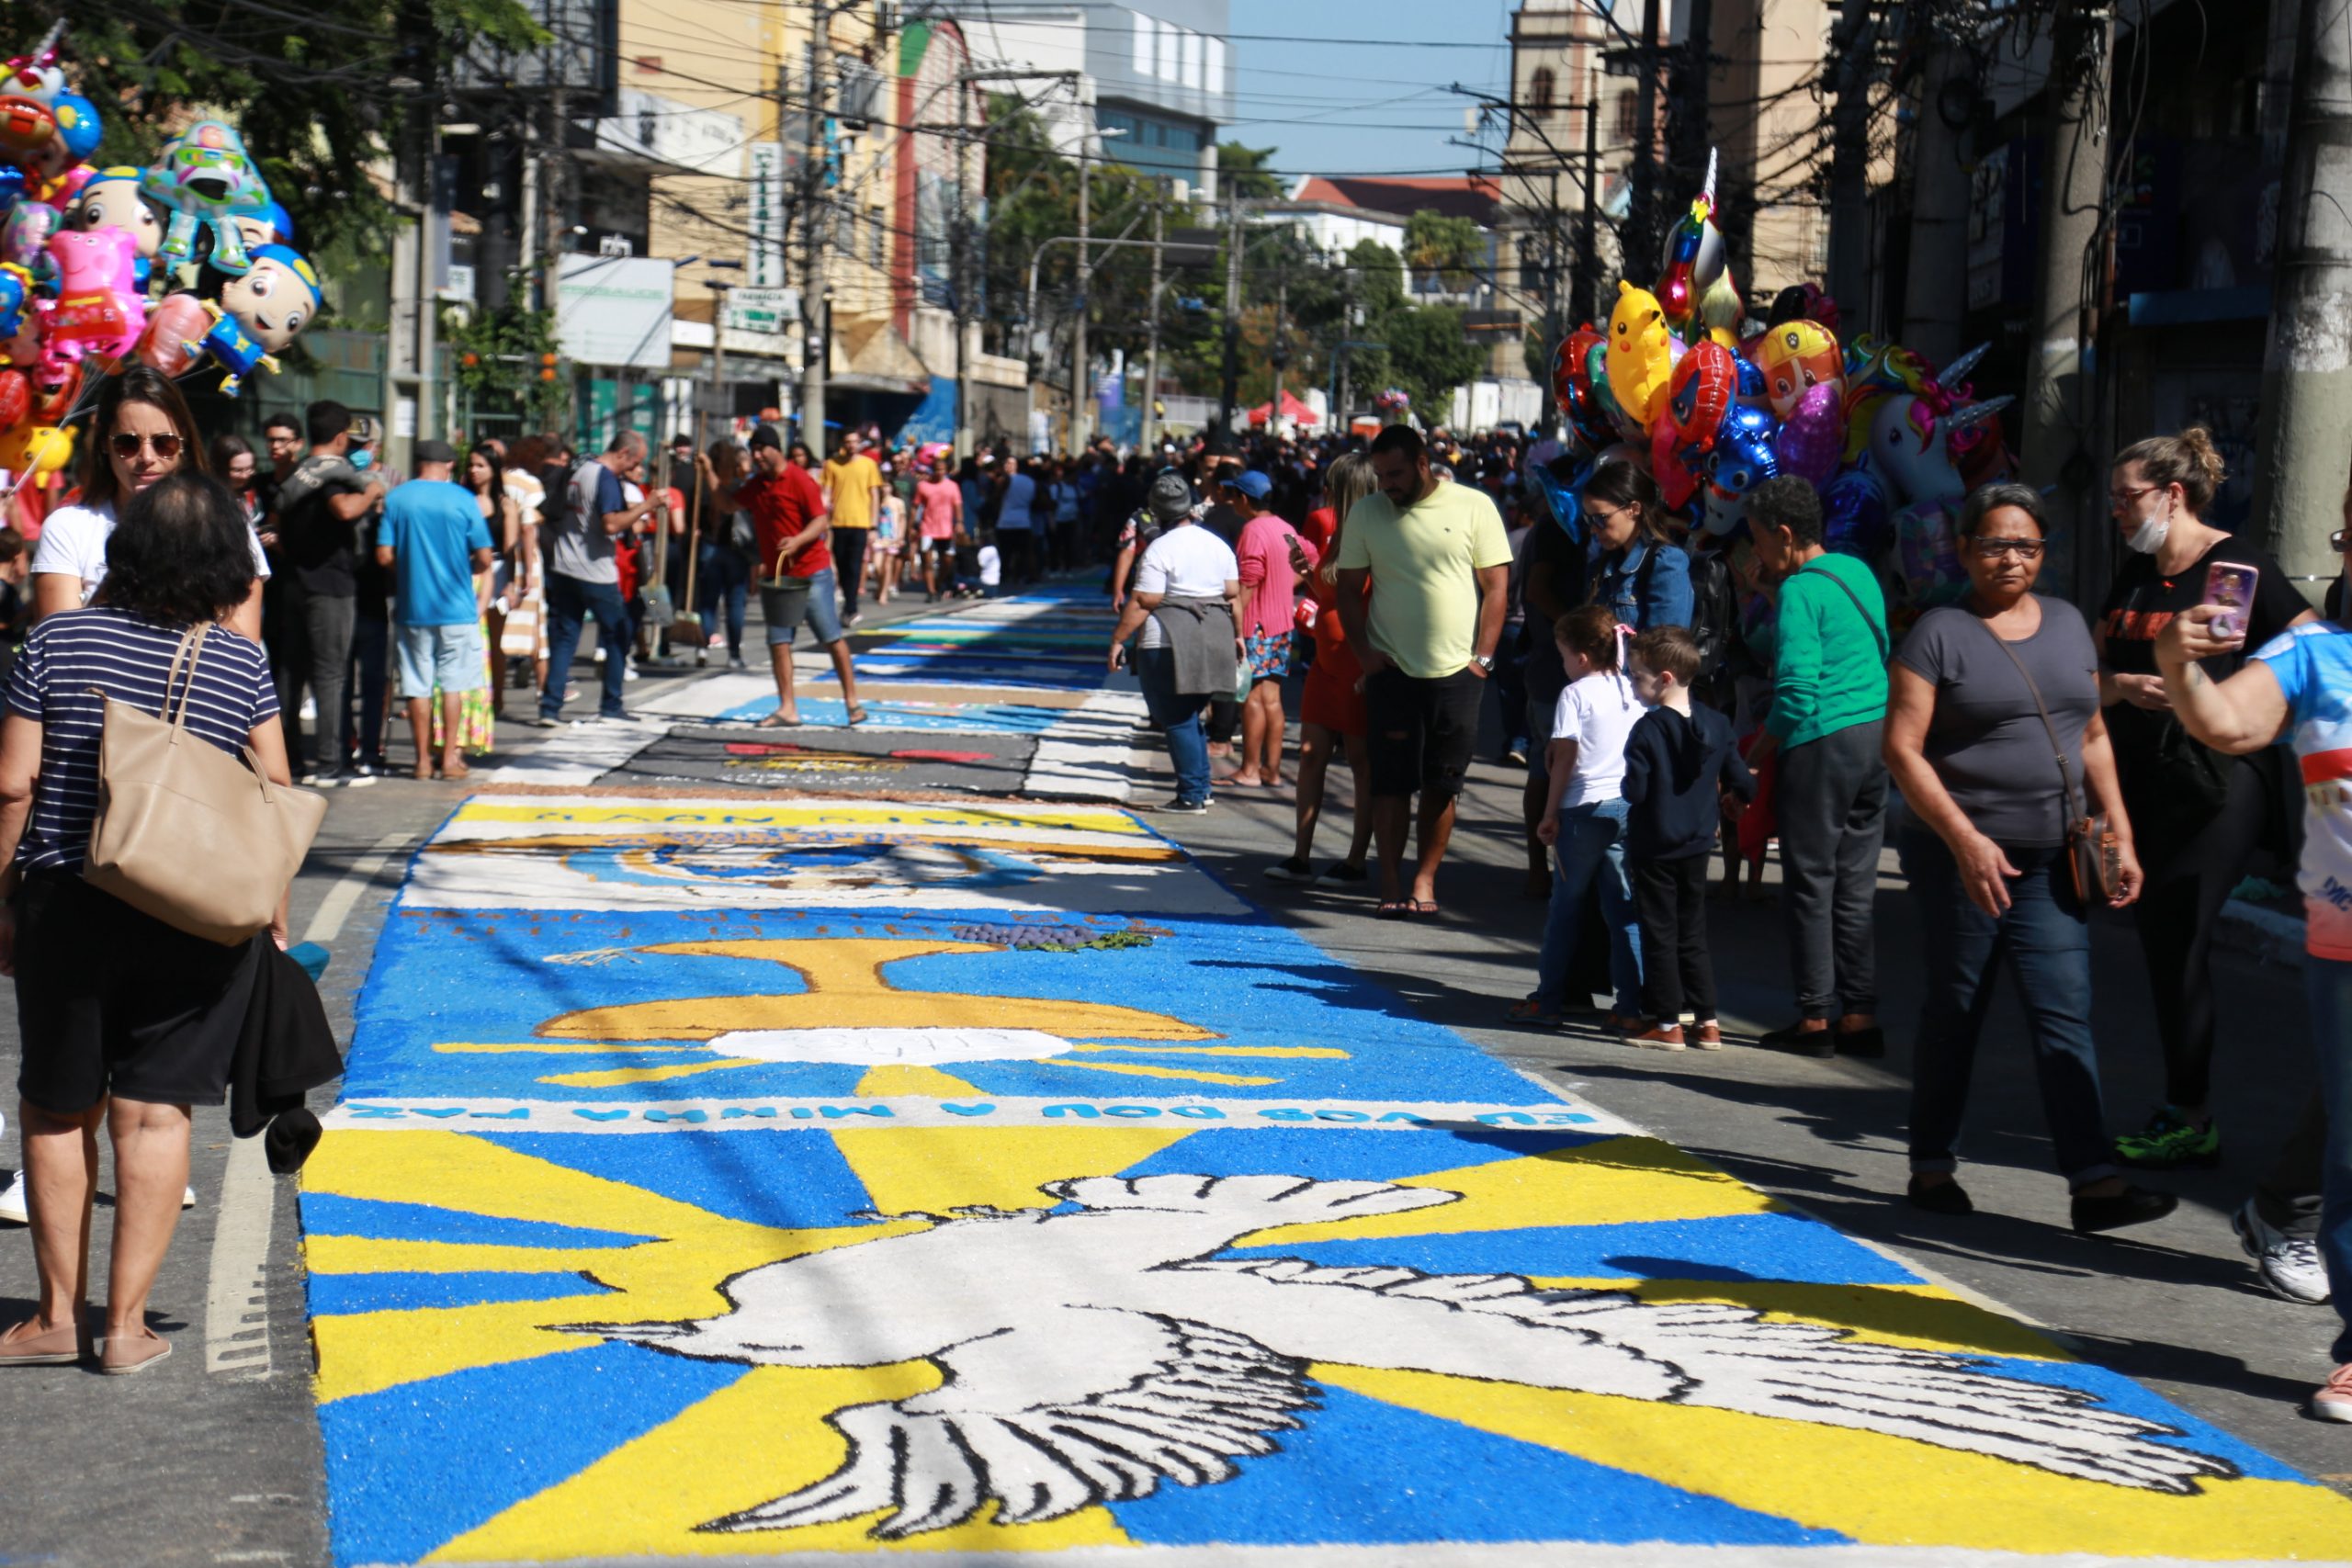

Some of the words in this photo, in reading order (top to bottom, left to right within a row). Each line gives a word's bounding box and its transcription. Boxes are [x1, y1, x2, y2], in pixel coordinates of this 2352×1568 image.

[346, 1103, 531, 1120] PAZ
[573, 1106, 895, 1122] MINHA
[942, 1105, 997, 1117] A
[1044, 1104, 1227, 1120] DOU
[1474, 1111, 1597, 1126] EU
